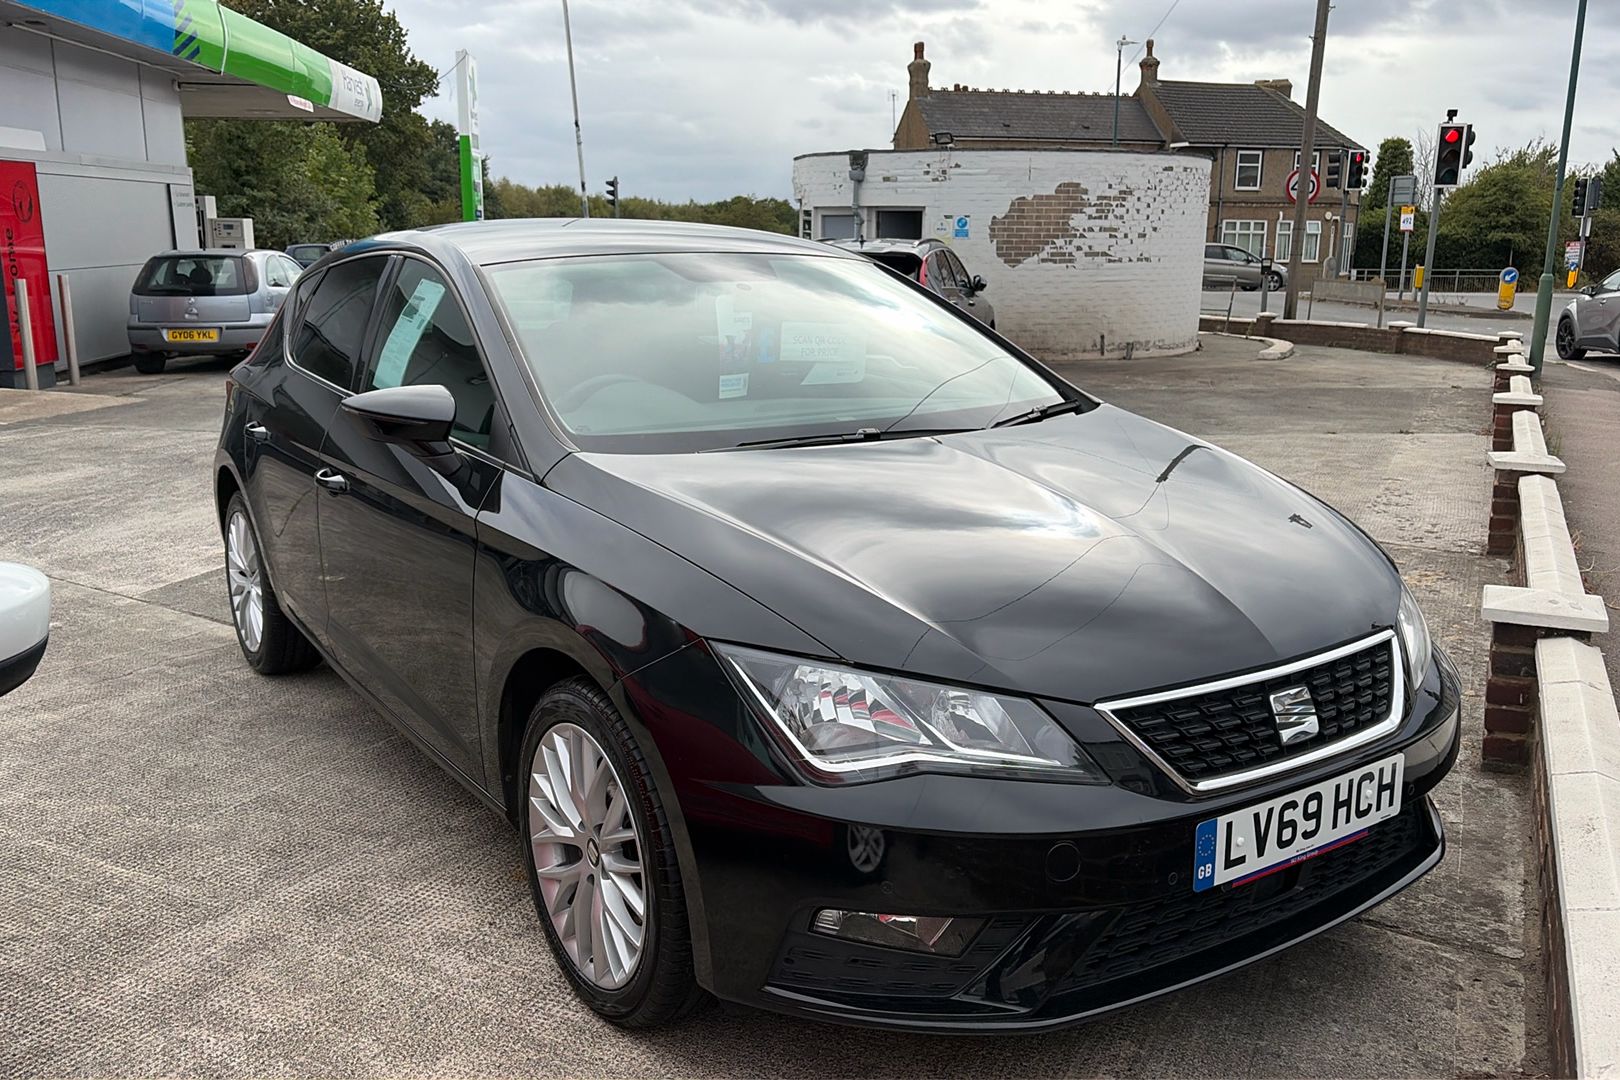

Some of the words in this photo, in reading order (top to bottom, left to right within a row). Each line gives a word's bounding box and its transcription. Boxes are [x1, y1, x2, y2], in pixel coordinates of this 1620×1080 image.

[1402, 217, 1412, 225] 492
[171, 331, 195, 339] GY06
[196, 331, 214, 339] YKL
[793, 335, 813, 345] SCAN
[801, 347, 816, 357] FOR
[1223, 791, 1323, 871] LV69
[1331, 762, 1398, 830] HCH
[1198, 863, 1212, 879] GB
